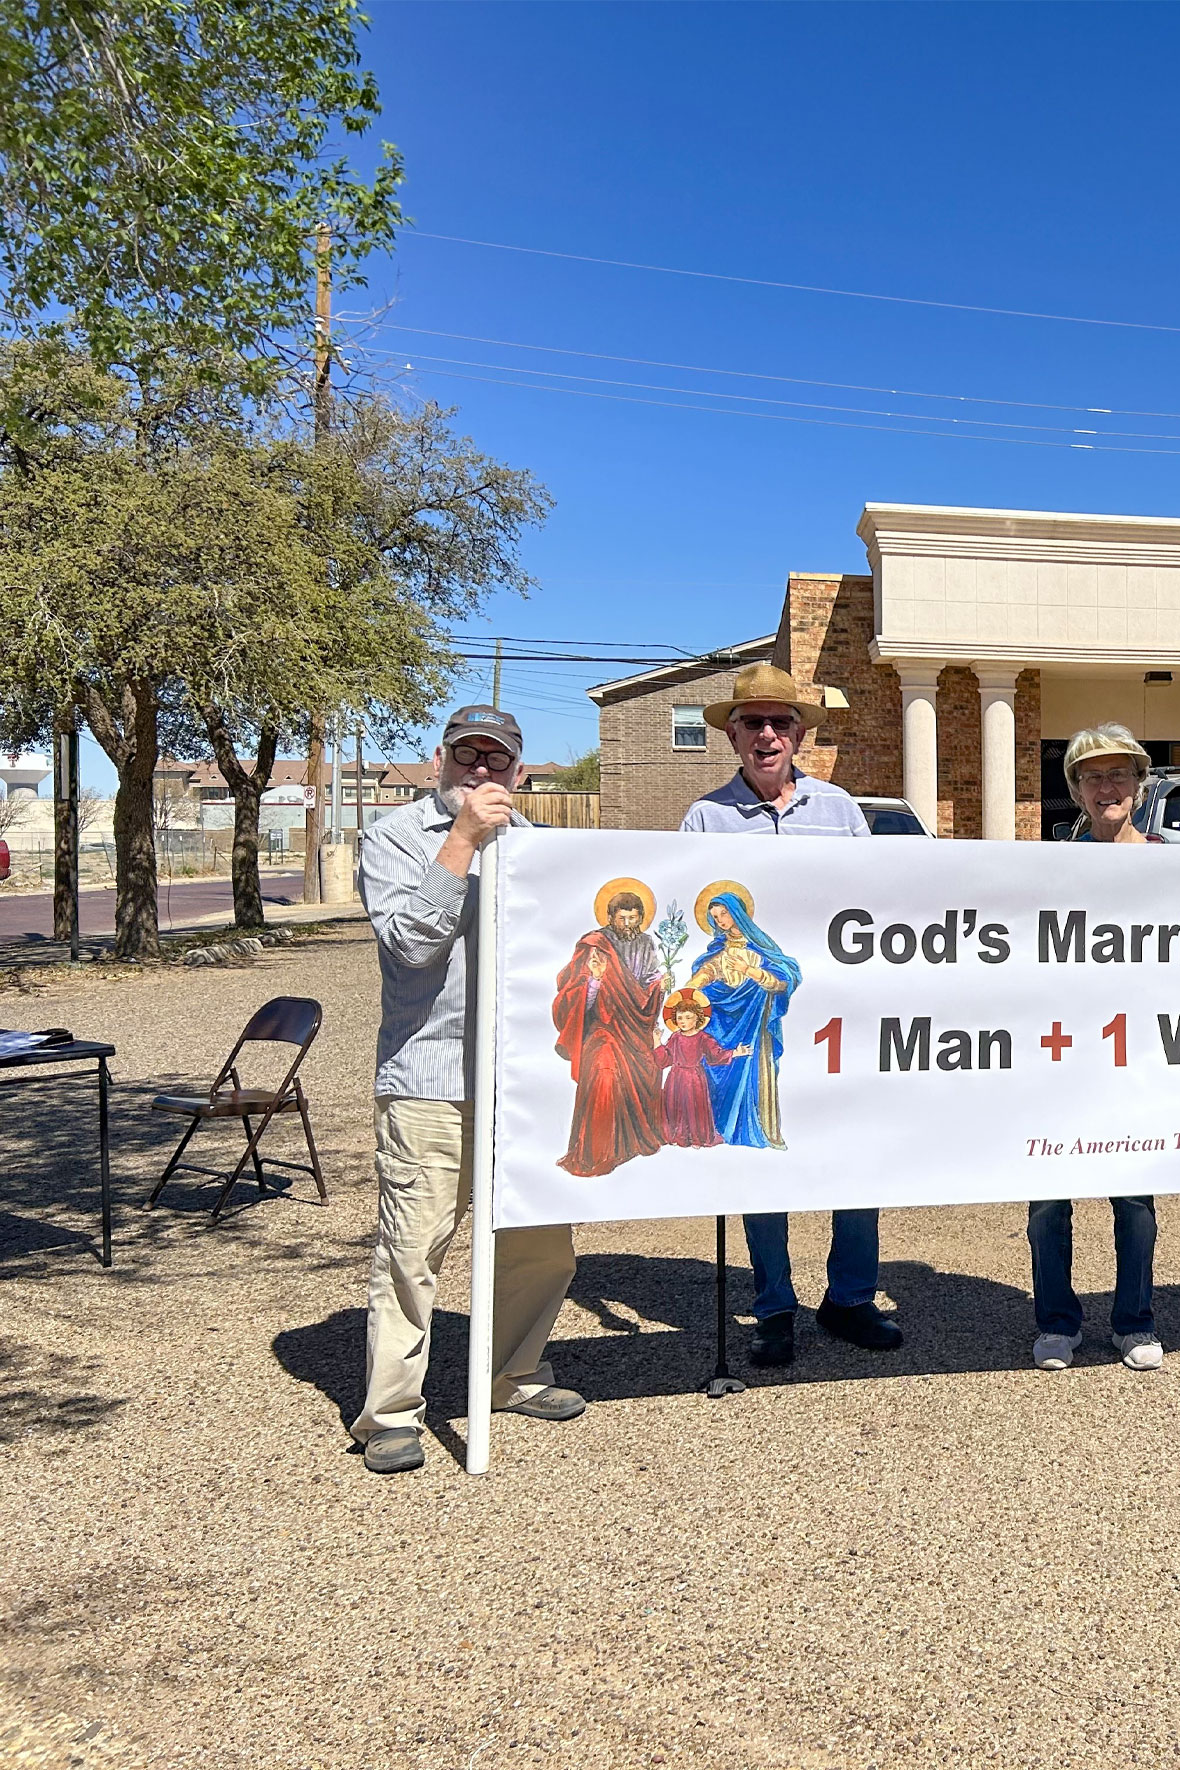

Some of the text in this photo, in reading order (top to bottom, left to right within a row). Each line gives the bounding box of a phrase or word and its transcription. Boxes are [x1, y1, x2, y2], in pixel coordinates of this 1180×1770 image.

[814, 1017, 843, 1074] 1
[879, 1016, 1012, 1073] Man
[1102, 1013, 1128, 1067] 1
[1026, 1138, 1064, 1157] The
[1068, 1134, 1166, 1155] American
